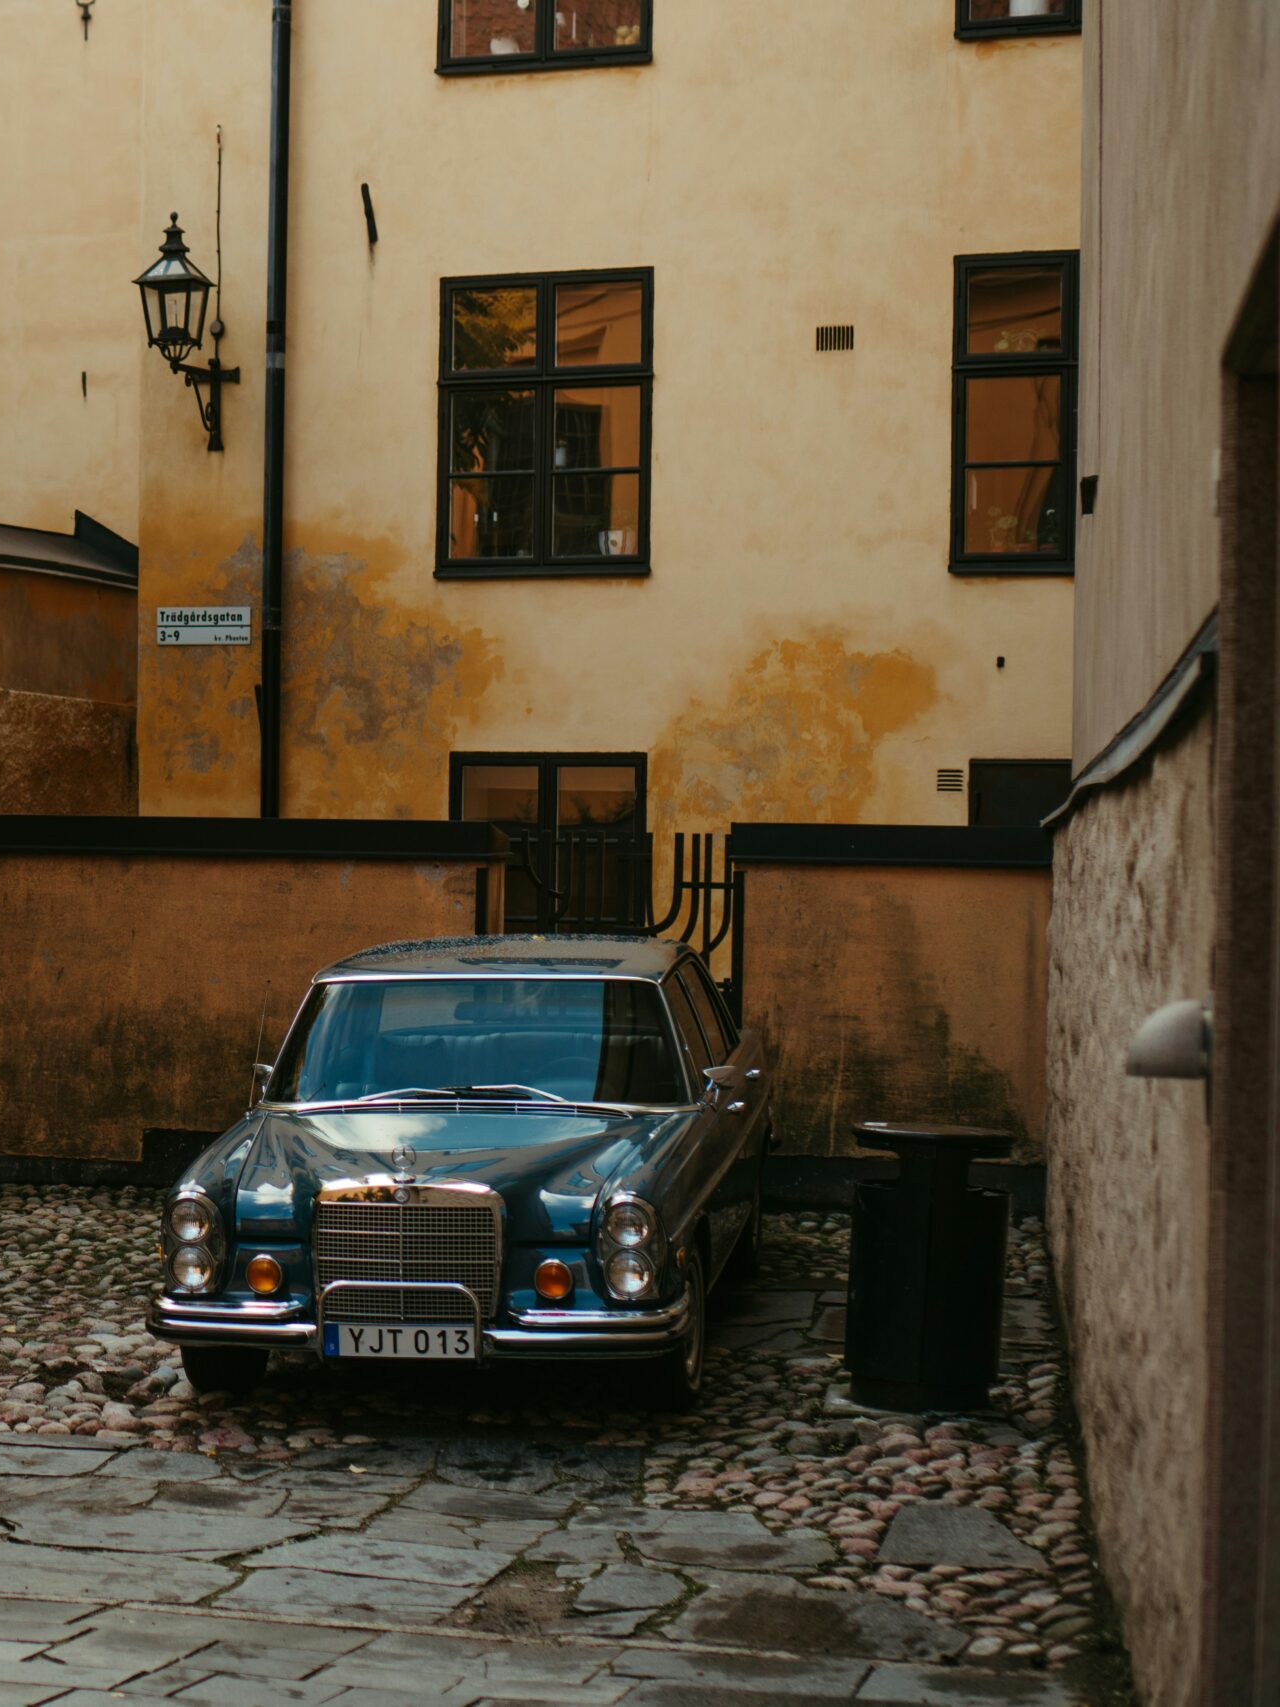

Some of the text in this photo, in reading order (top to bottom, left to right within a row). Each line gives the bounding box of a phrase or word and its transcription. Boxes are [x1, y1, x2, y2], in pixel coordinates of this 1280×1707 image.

[160, 610, 243, 625] Trädgårdsgatan
[160, 630, 180, 641] 3-9
[348, 1327, 470, 1355] YJT 013
